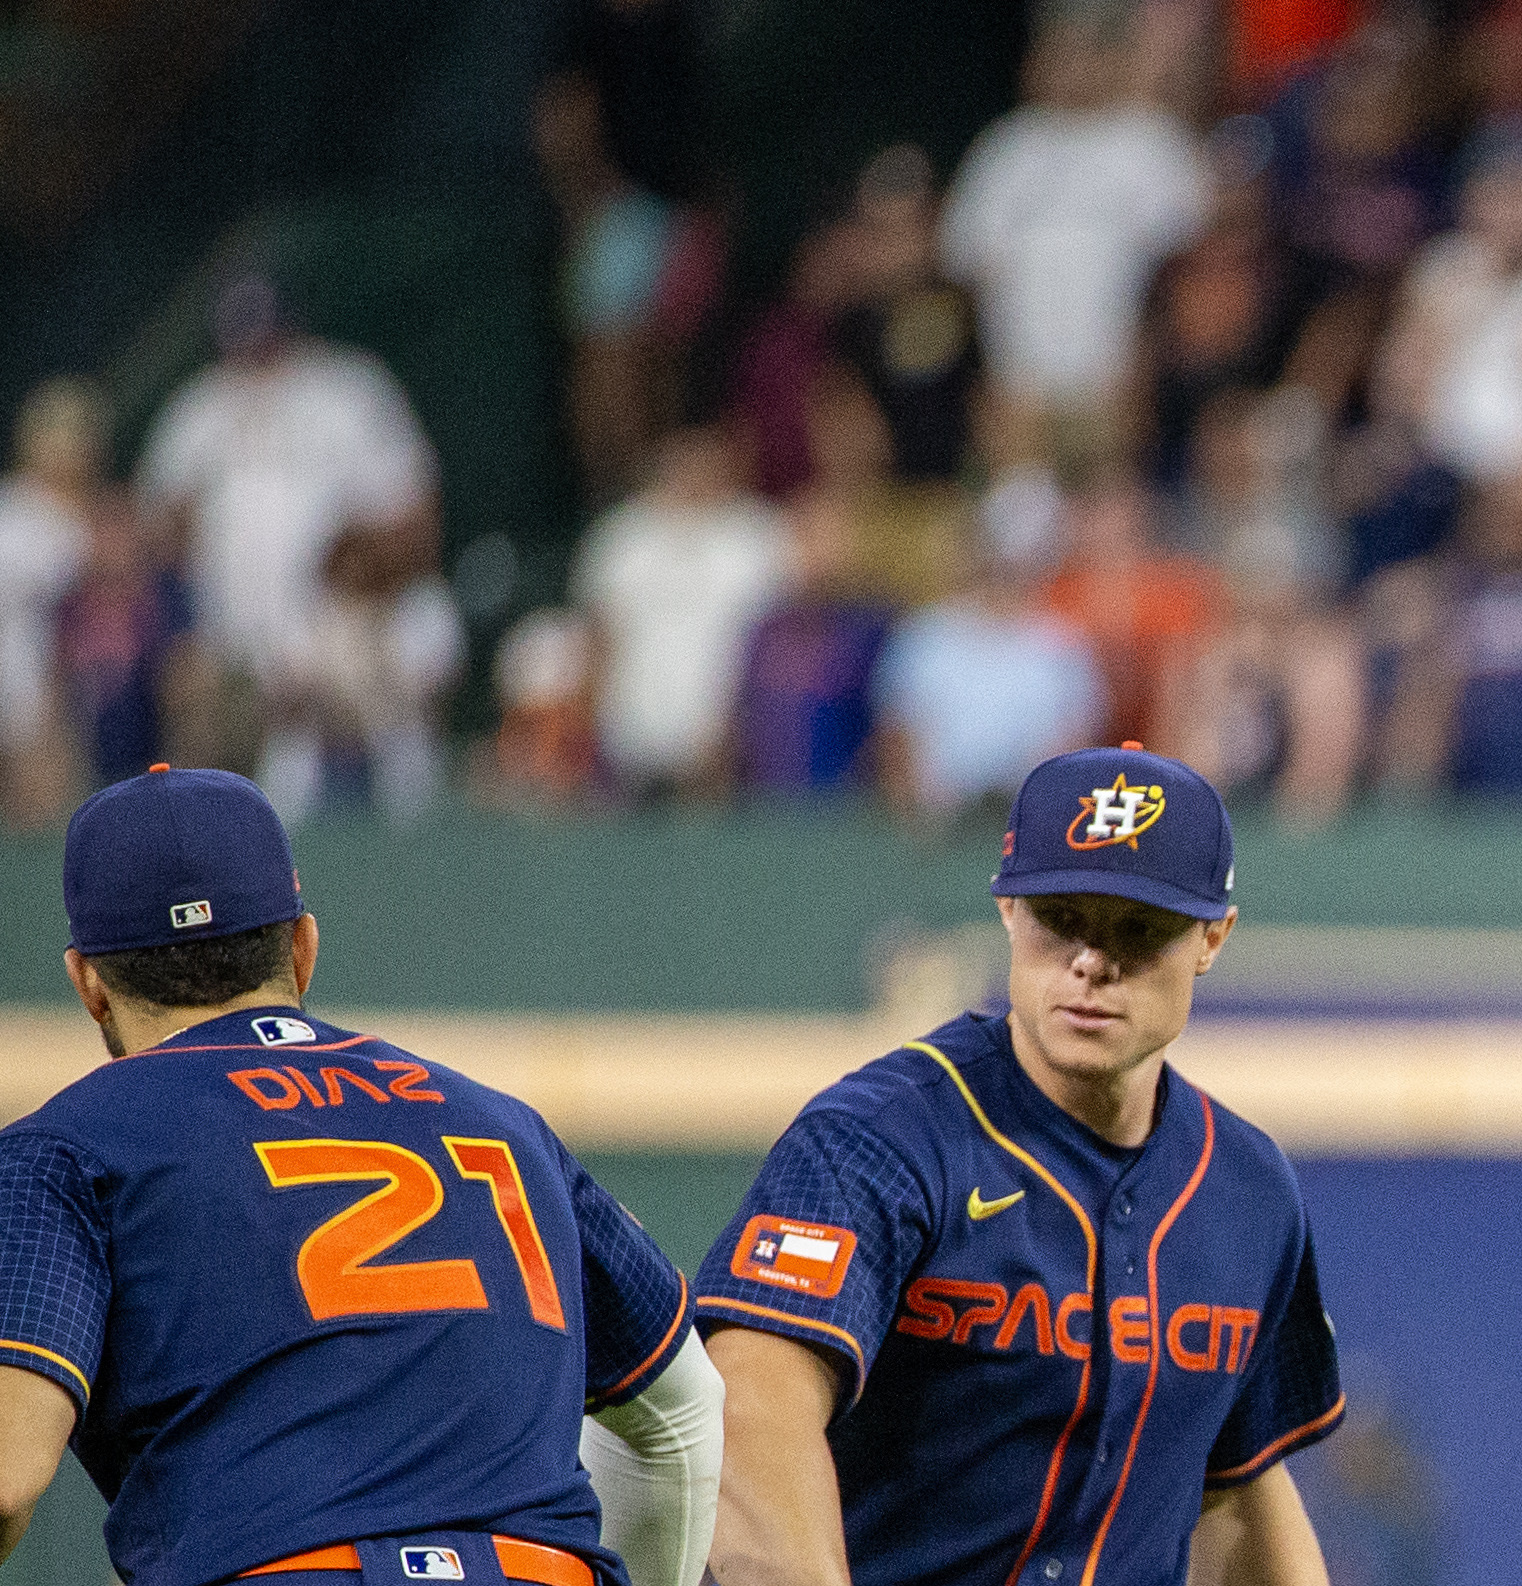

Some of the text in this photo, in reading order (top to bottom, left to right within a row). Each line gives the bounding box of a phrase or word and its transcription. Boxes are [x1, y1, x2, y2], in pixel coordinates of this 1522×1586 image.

[227, 1060, 446, 1111] DIAZ
[253, 1136, 566, 1330] 21
[897, 1277, 1149, 1363] SPACE
